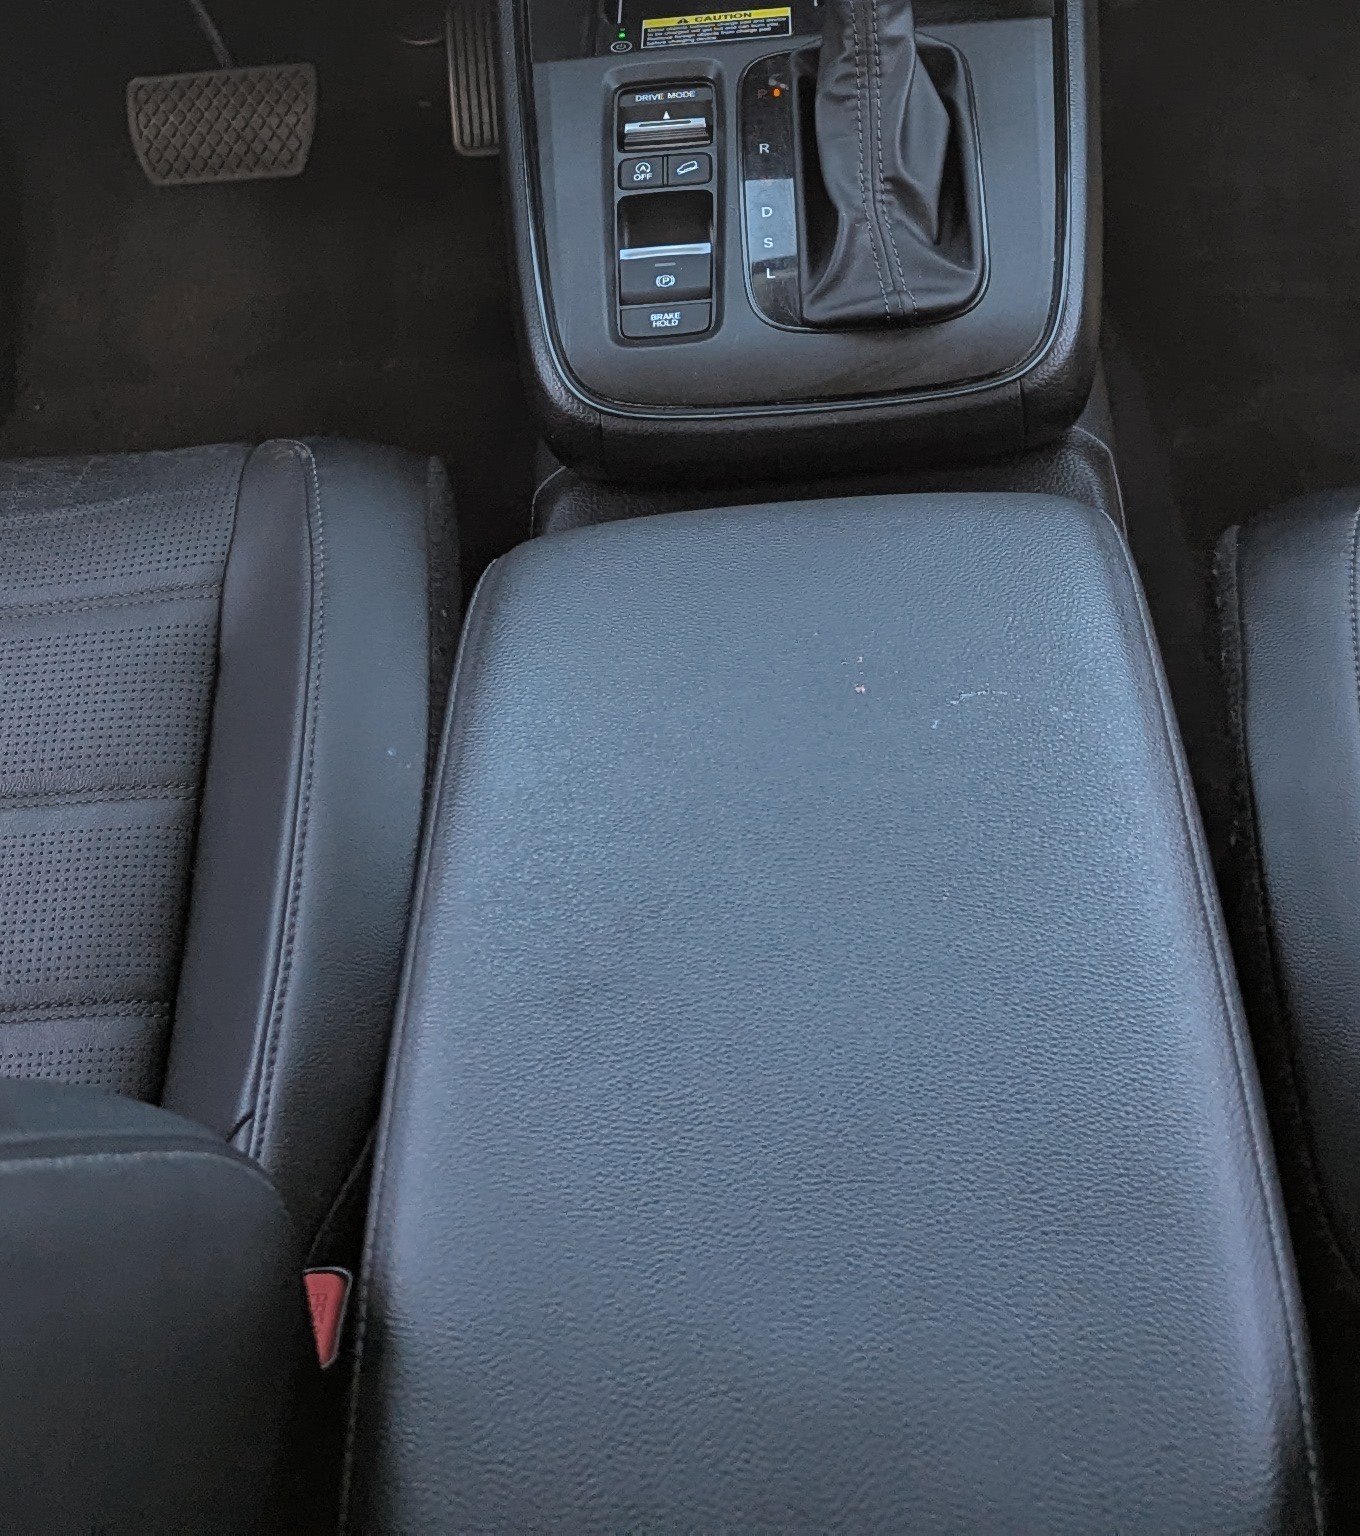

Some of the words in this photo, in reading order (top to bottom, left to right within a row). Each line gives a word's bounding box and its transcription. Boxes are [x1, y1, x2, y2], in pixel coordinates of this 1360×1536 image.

[695, 12, 752, 23] CAUTION
[635, 93, 664, 102] DRIVE
[667, 90, 696, 99] MODE
[759, 143, 770, 154] R
[633, 173, 653, 181] OFF
[761, 206, 773, 218] D
[763, 237, 774, 248] S
[766, 268, 776, 279] L
[650, 312, 681, 322] BRAKE
[652, 319, 679, 328] HOLD
